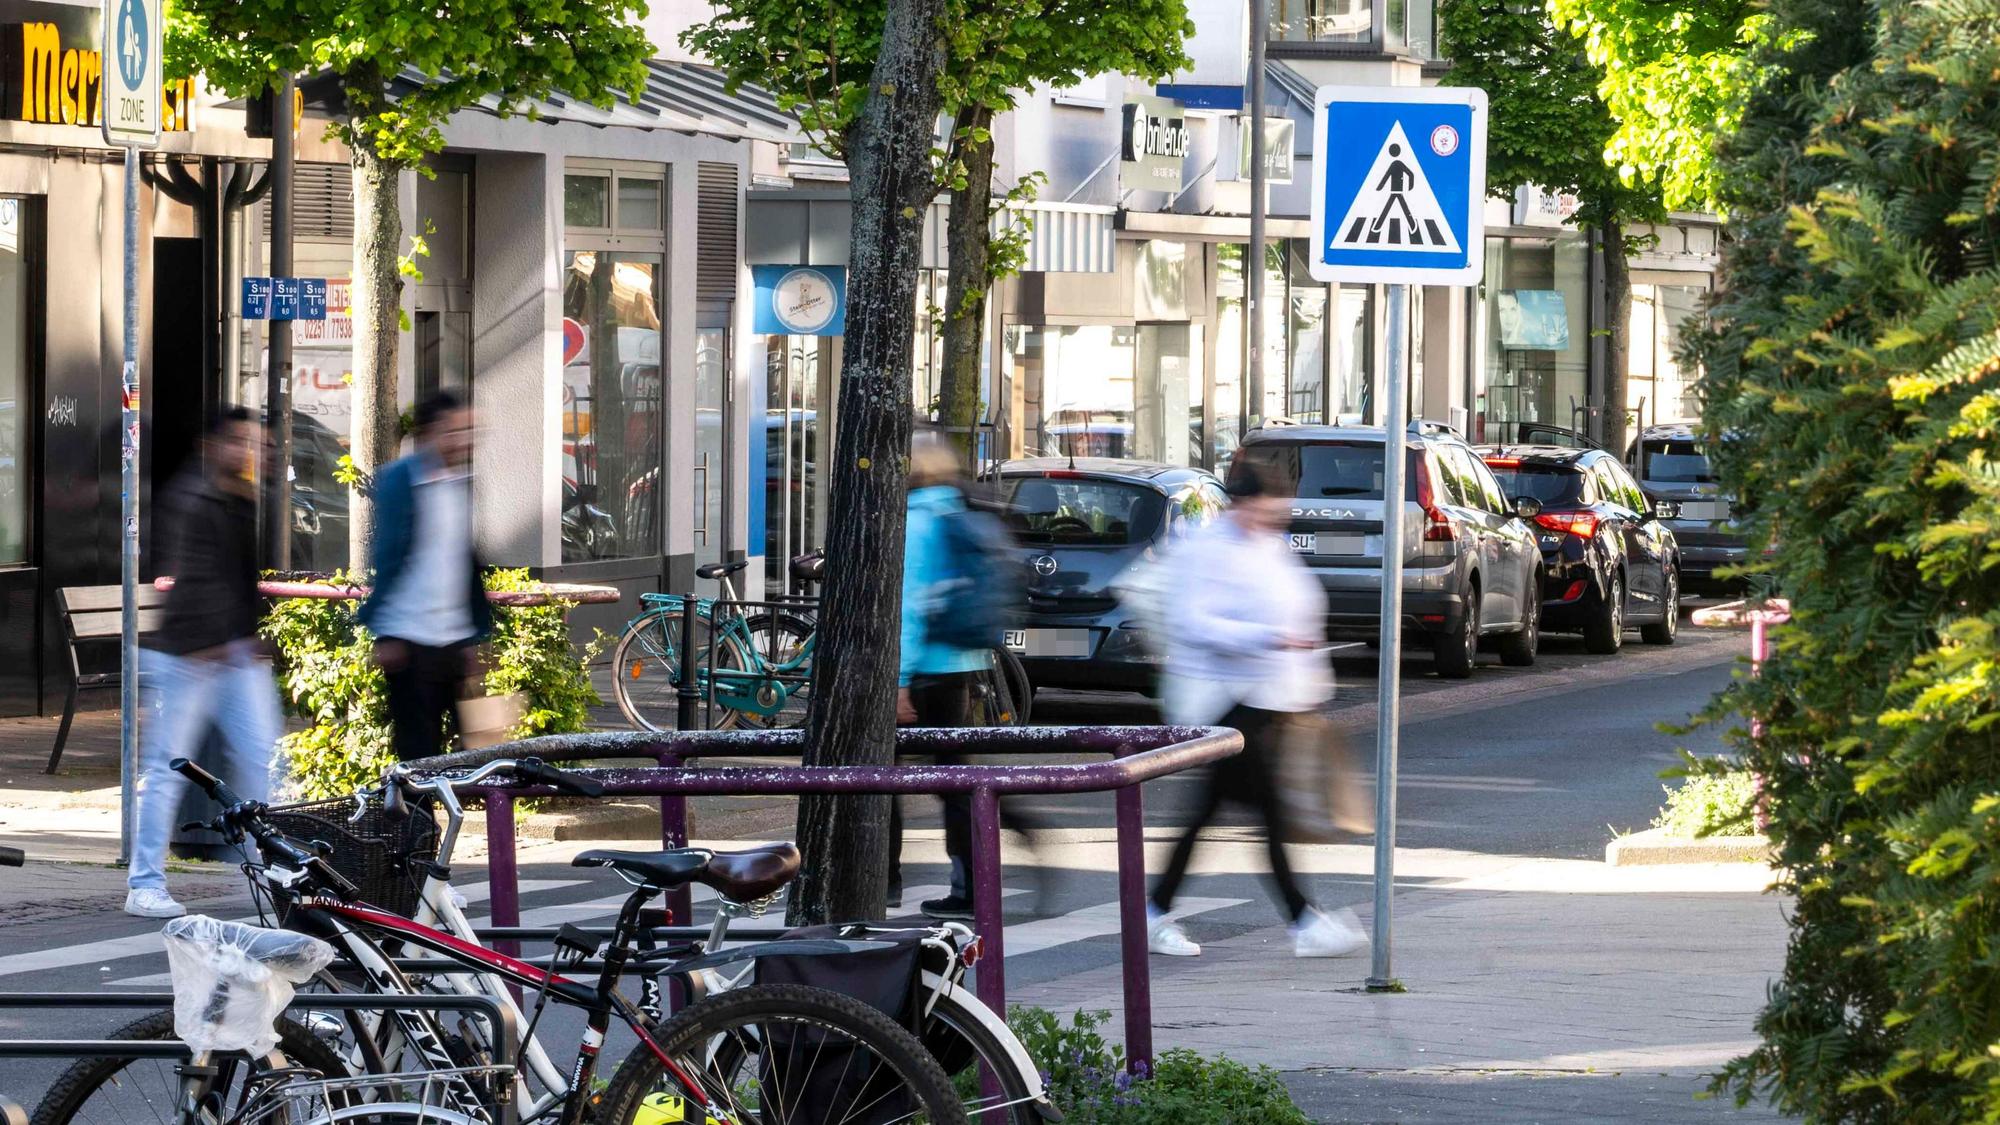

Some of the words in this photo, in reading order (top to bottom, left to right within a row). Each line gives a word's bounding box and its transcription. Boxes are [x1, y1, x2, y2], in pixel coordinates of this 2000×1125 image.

[121, 98, 145, 123] ZONE
[1146, 115, 1190, 158] brillen.de
[1291, 508, 1355, 518] DACIA
[1291, 534, 1310, 549] SU
[1003, 631, 1025, 647] EU
